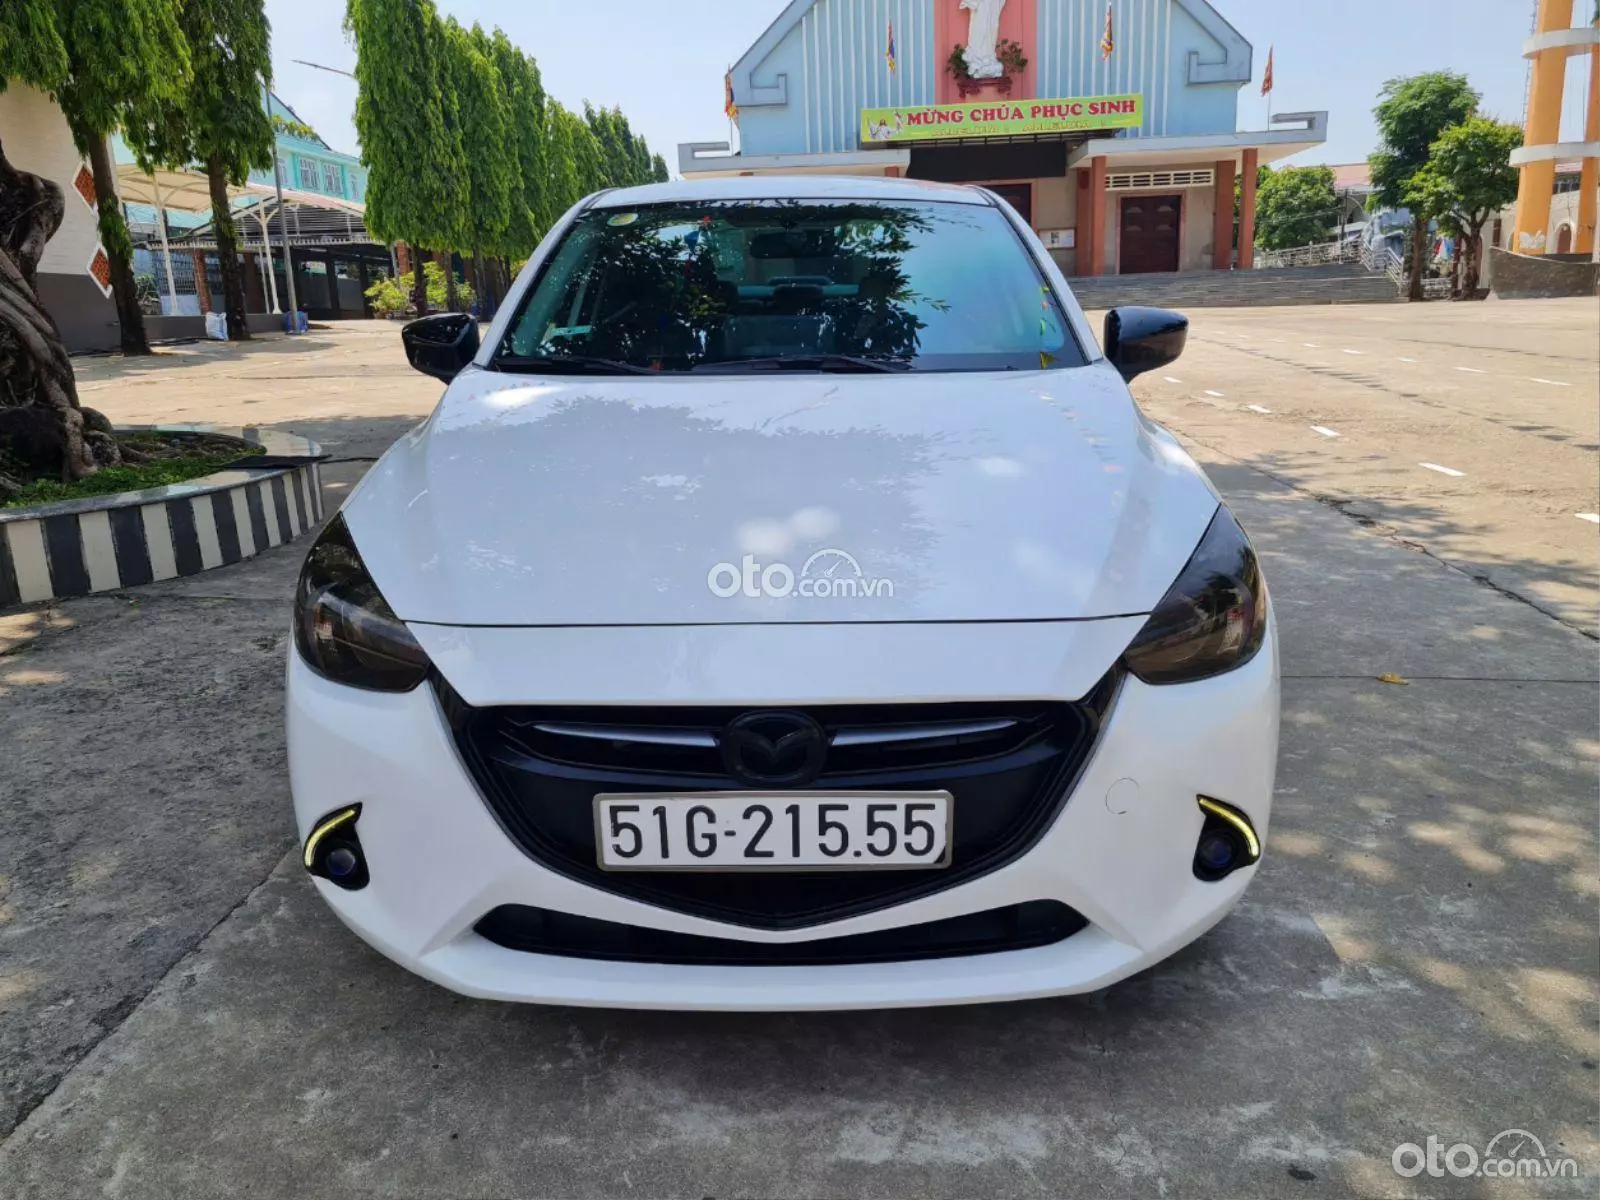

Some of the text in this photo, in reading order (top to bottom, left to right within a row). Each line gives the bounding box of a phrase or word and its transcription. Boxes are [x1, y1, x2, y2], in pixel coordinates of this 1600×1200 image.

[907, 100, 1136, 125] MỪNG CHÚA PHỤC SINH
[609, 803, 936, 859] 51G-215.55
